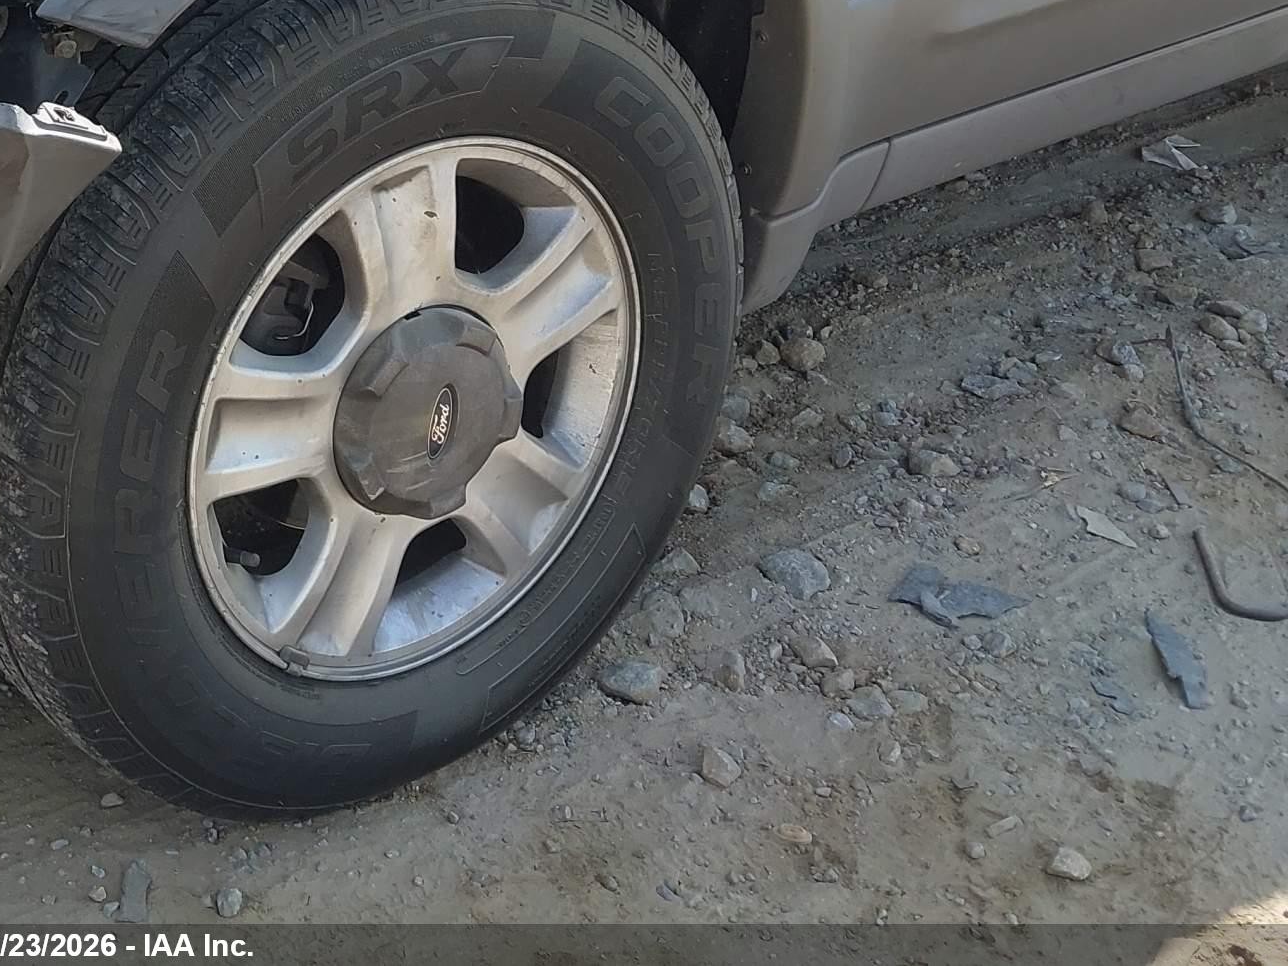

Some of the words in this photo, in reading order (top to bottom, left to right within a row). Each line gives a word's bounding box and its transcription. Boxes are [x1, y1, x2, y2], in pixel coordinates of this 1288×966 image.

[287, 46, 469, 186] SRX
[594, 76, 723, 403] COOPER
[431, 403, 450, 445] Ford
